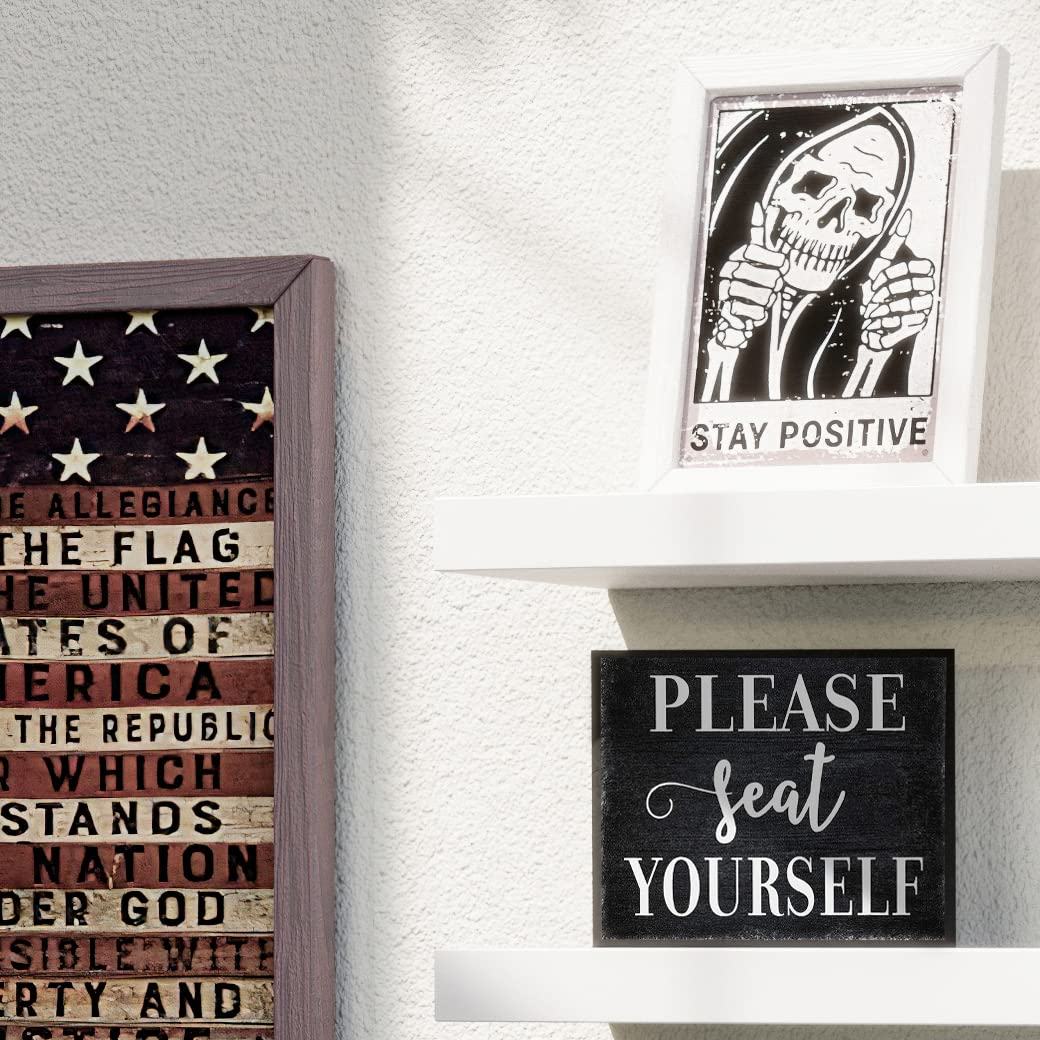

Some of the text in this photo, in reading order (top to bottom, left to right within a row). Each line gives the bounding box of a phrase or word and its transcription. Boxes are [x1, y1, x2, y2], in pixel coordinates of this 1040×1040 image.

[690, 417, 928, 451] STAY POSITIVE
[0, 491, 25, 519] E
[114, 528, 239, 565] FLAG
[81, 571, 274, 611] UNITED
[163, 617, 230, 655] OF
[0, 662, 222, 702] ERICA
[649, 673, 906, 732] PLEASE
[15, 708, 274, 744] THE REPUBLIC
[43, 753, 221, 792] WHICH
[646, 741, 846, 844] seat
[1, 801, 222, 836] STANDS
[33, 844, 257, 884] NATION
[623, 856, 924, 917] YOURSELF
[0, 890, 224, 926] DER GOD
[0, 981, 240, 1019] RTY AND
